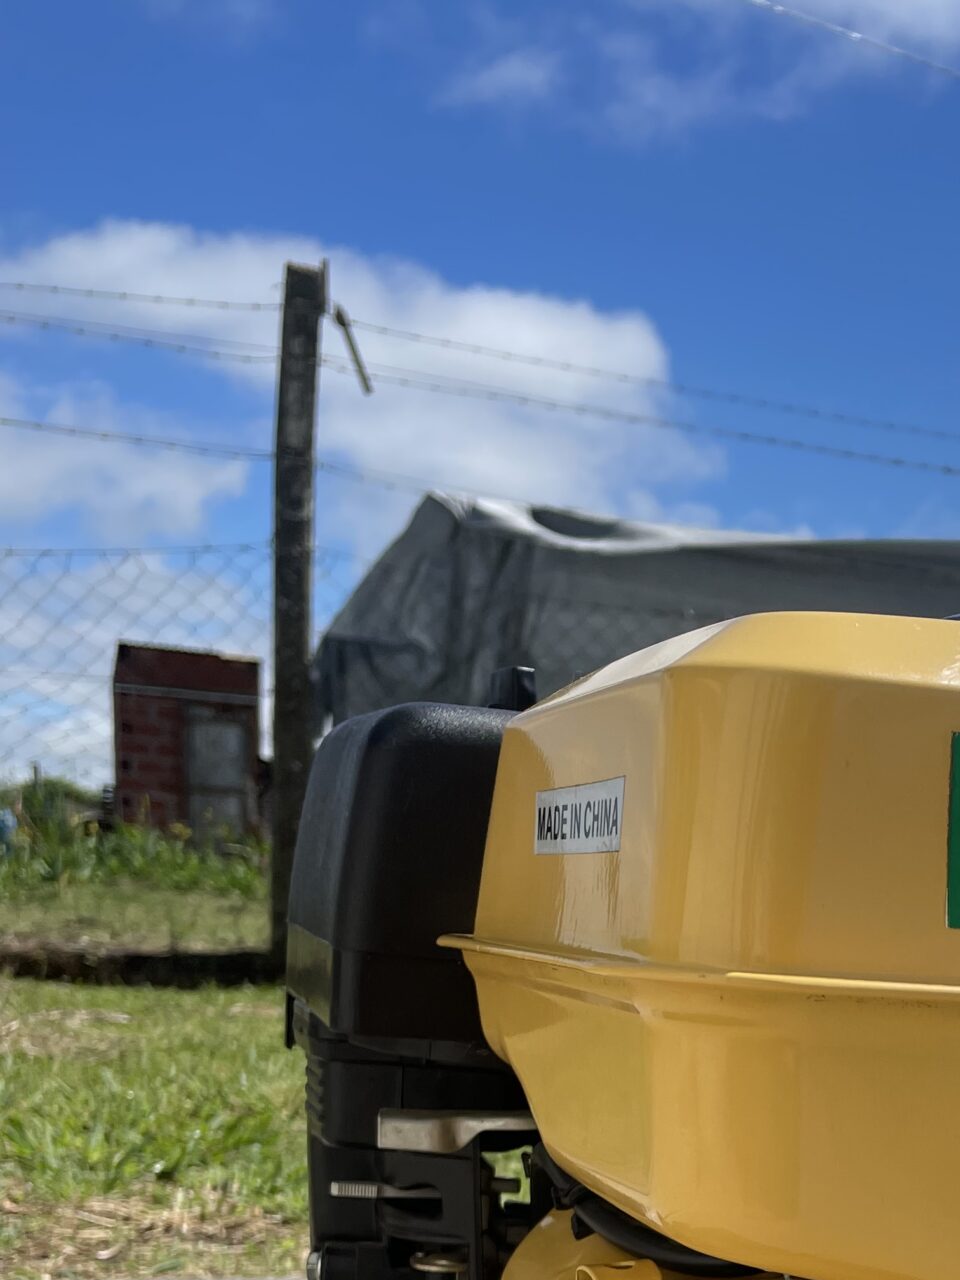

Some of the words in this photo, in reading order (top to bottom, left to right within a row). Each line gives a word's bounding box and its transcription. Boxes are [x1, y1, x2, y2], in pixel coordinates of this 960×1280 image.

[537, 804, 568, 840] MADE
[570, 803, 581, 839] IN
[584, 797, 618, 839] CHINA
